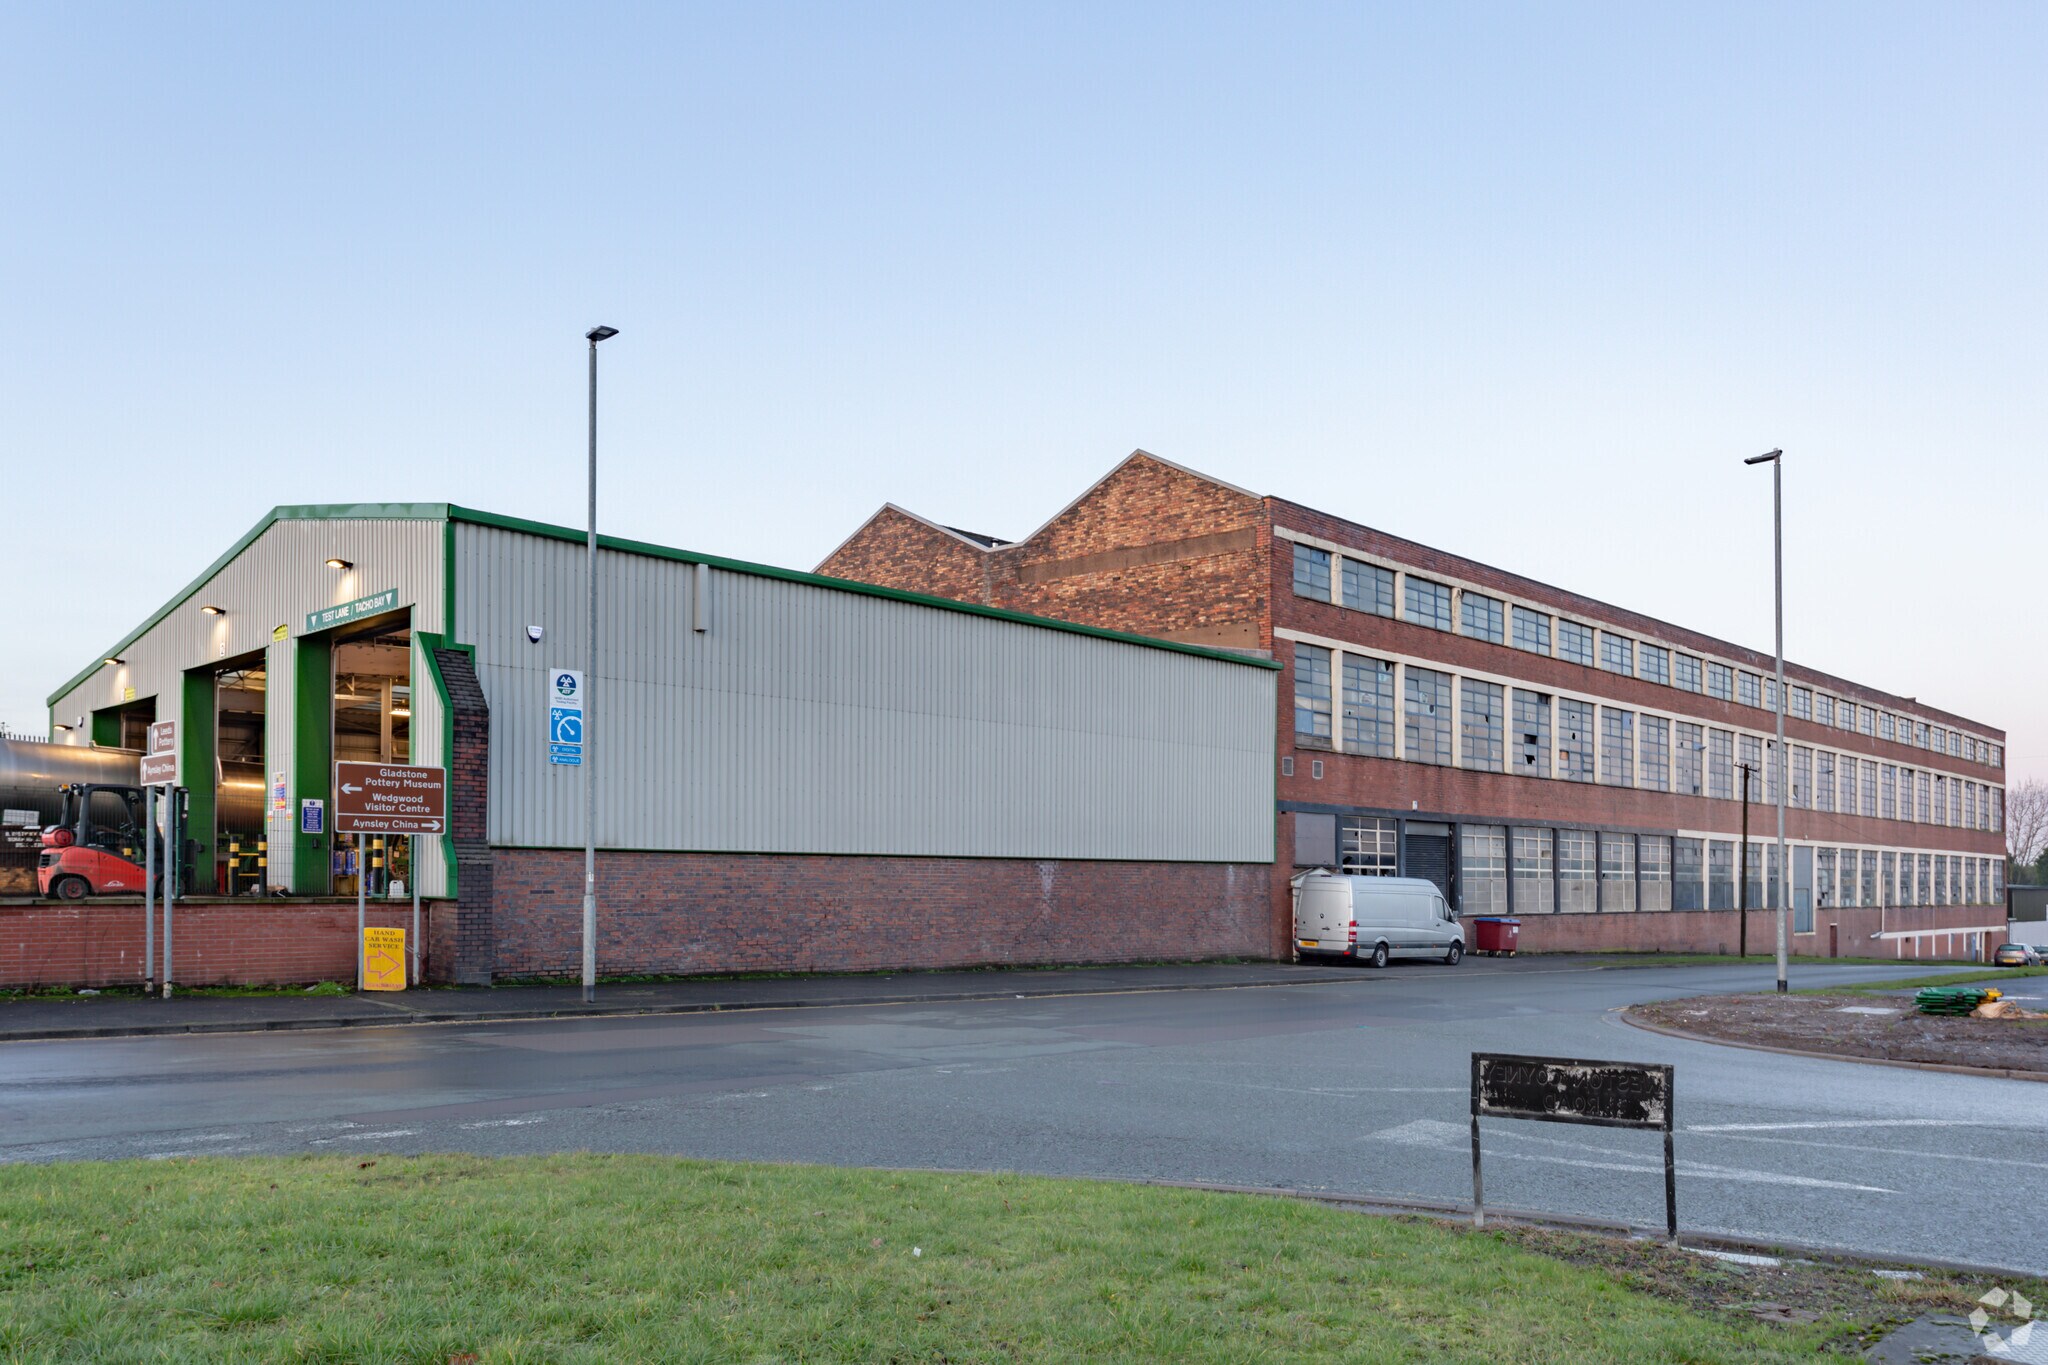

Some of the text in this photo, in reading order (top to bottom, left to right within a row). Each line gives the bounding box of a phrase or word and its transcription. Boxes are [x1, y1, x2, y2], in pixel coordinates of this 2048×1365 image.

[322, 611, 334, 623] TEST
[335, 606, 349, 619] LANE
[355, 599, 374, 613] TACHO
[374, 595, 386, 607] BAY
[160, 726, 172, 736] Leeds
[158, 737, 174, 747] Pottery
[147, 763, 175, 776] Aynsley China
[379, 768, 428, 778] Gladstone
[365, 777, 442, 789] Pottery Museum
[372, 793, 424, 803] Wedgwood
[365, 802, 431, 813] Visitor Centre
[353, 818, 419, 829] Aynsley China
